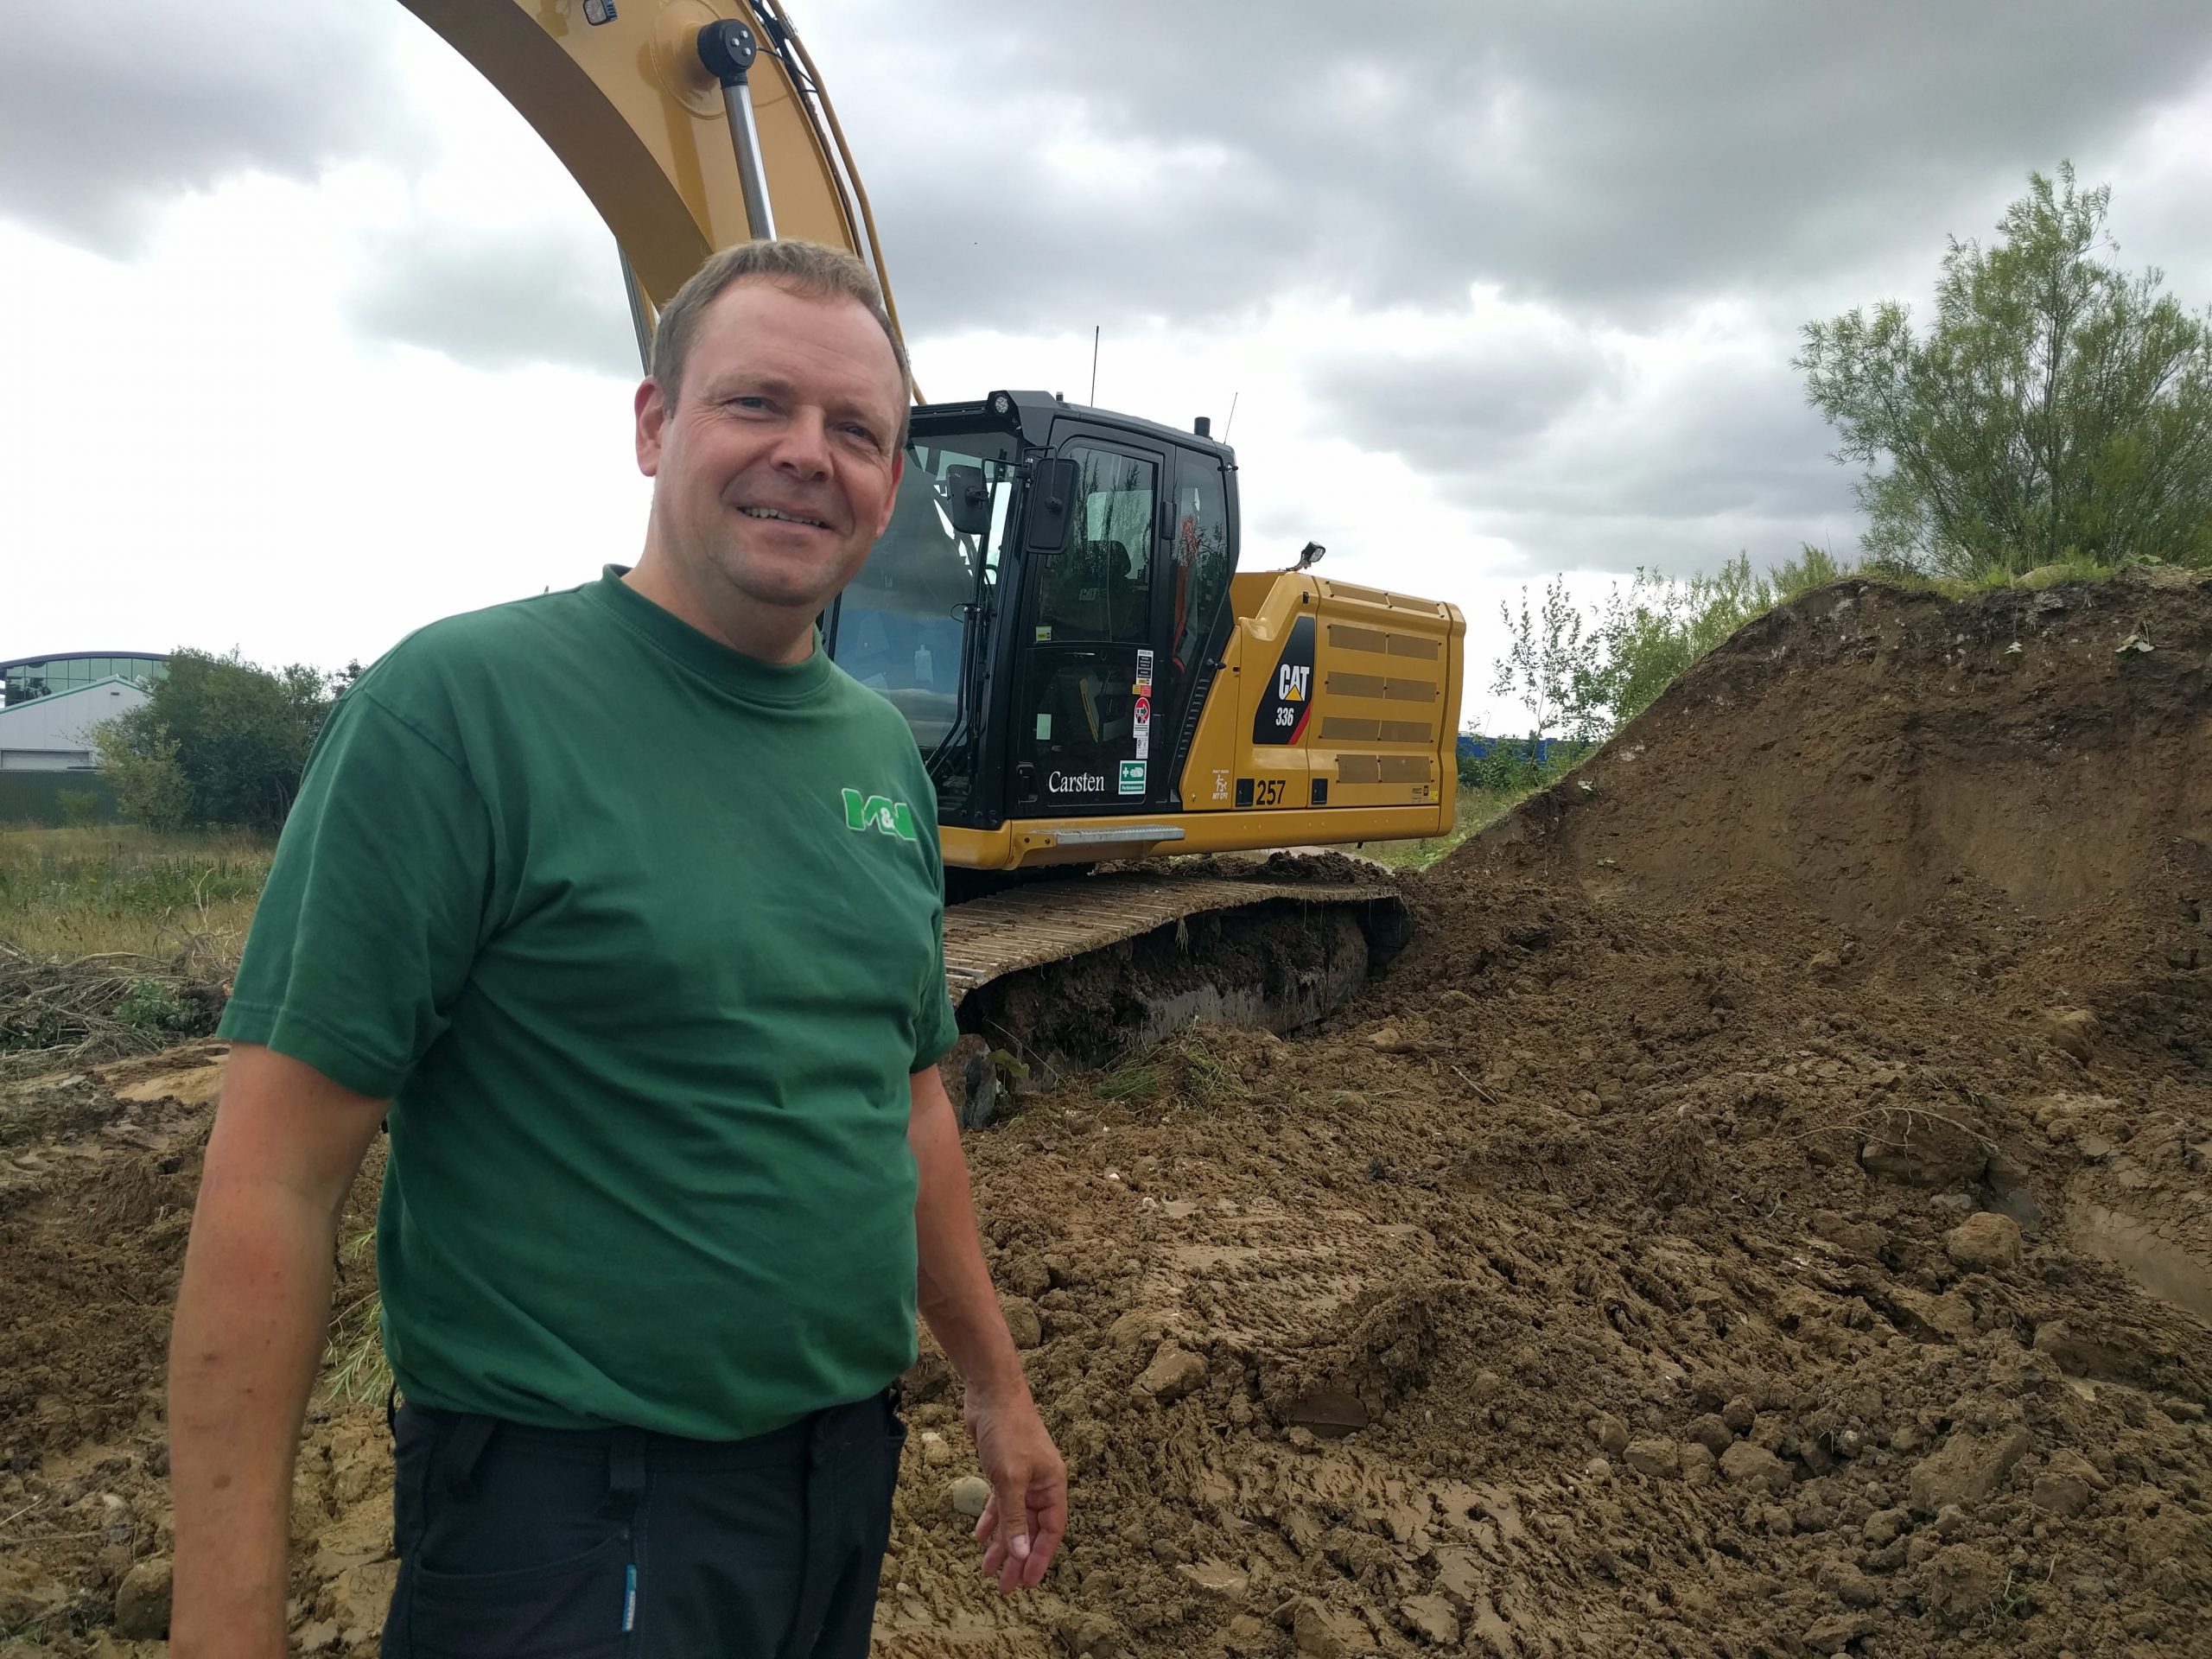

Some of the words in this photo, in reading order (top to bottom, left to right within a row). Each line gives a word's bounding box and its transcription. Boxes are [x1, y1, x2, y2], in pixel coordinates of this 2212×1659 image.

[1279, 664, 1310, 702] CAT
[1275, 707, 1294, 726] 336
[1048, 771, 1105, 793] Carsten
[1255, 779, 1287, 805] 257
